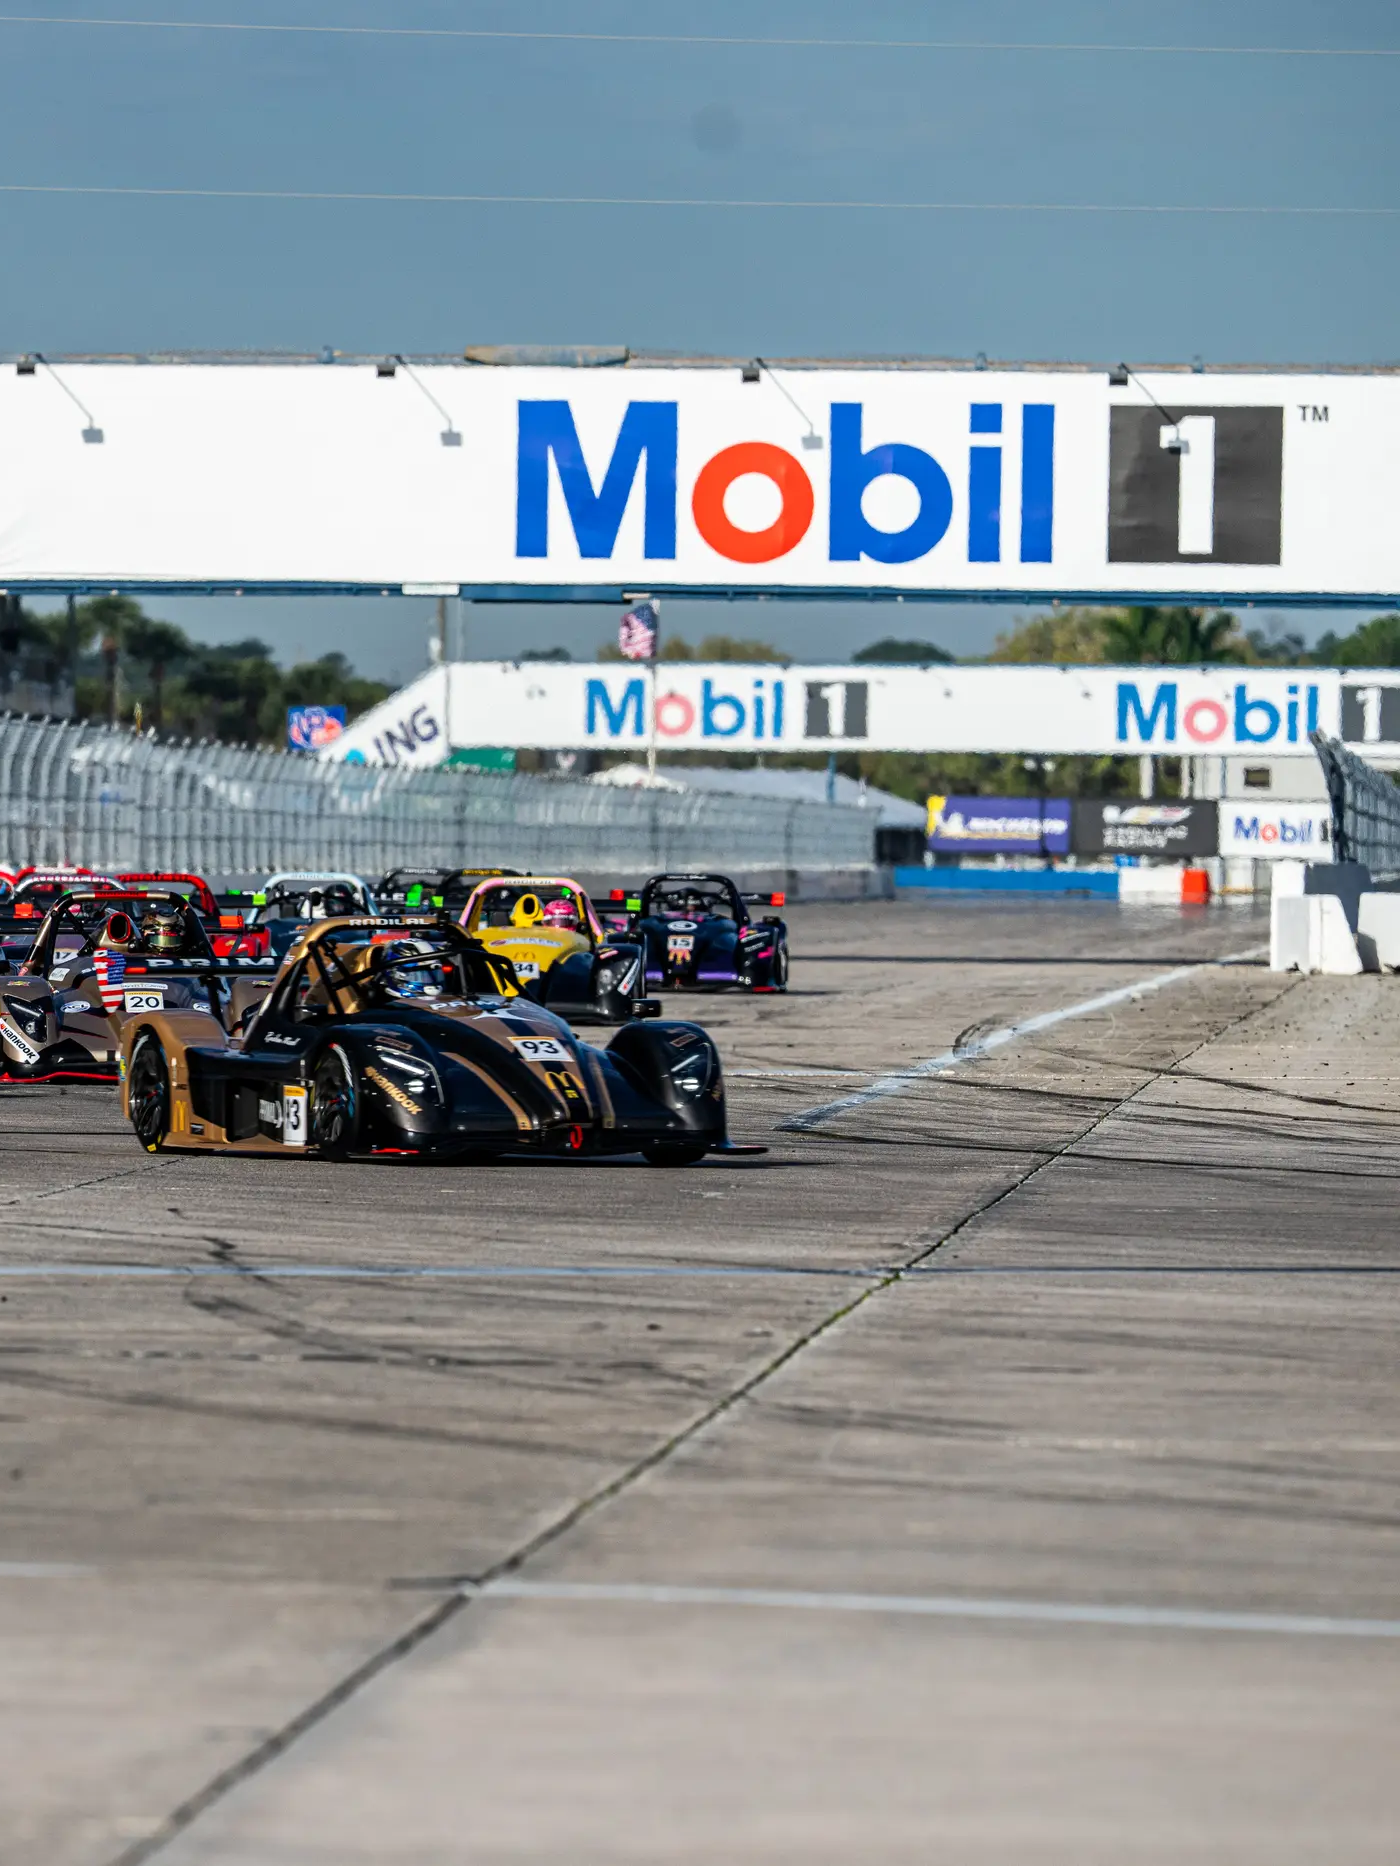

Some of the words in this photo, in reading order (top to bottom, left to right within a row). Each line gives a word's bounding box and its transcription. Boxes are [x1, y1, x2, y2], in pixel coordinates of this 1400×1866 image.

[515, 400, 1055, 565] Mobil
[1160, 415, 1215, 554] 1
[584, 677, 785, 739] Mobil
[1116, 682, 1319, 743] Mobil
[1234, 816, 1313, 843] Mobil
[514, 963, 534, 974] 34
[129, 996, 160, 1009] 20
[521, 1040, 559, 1055] 93
